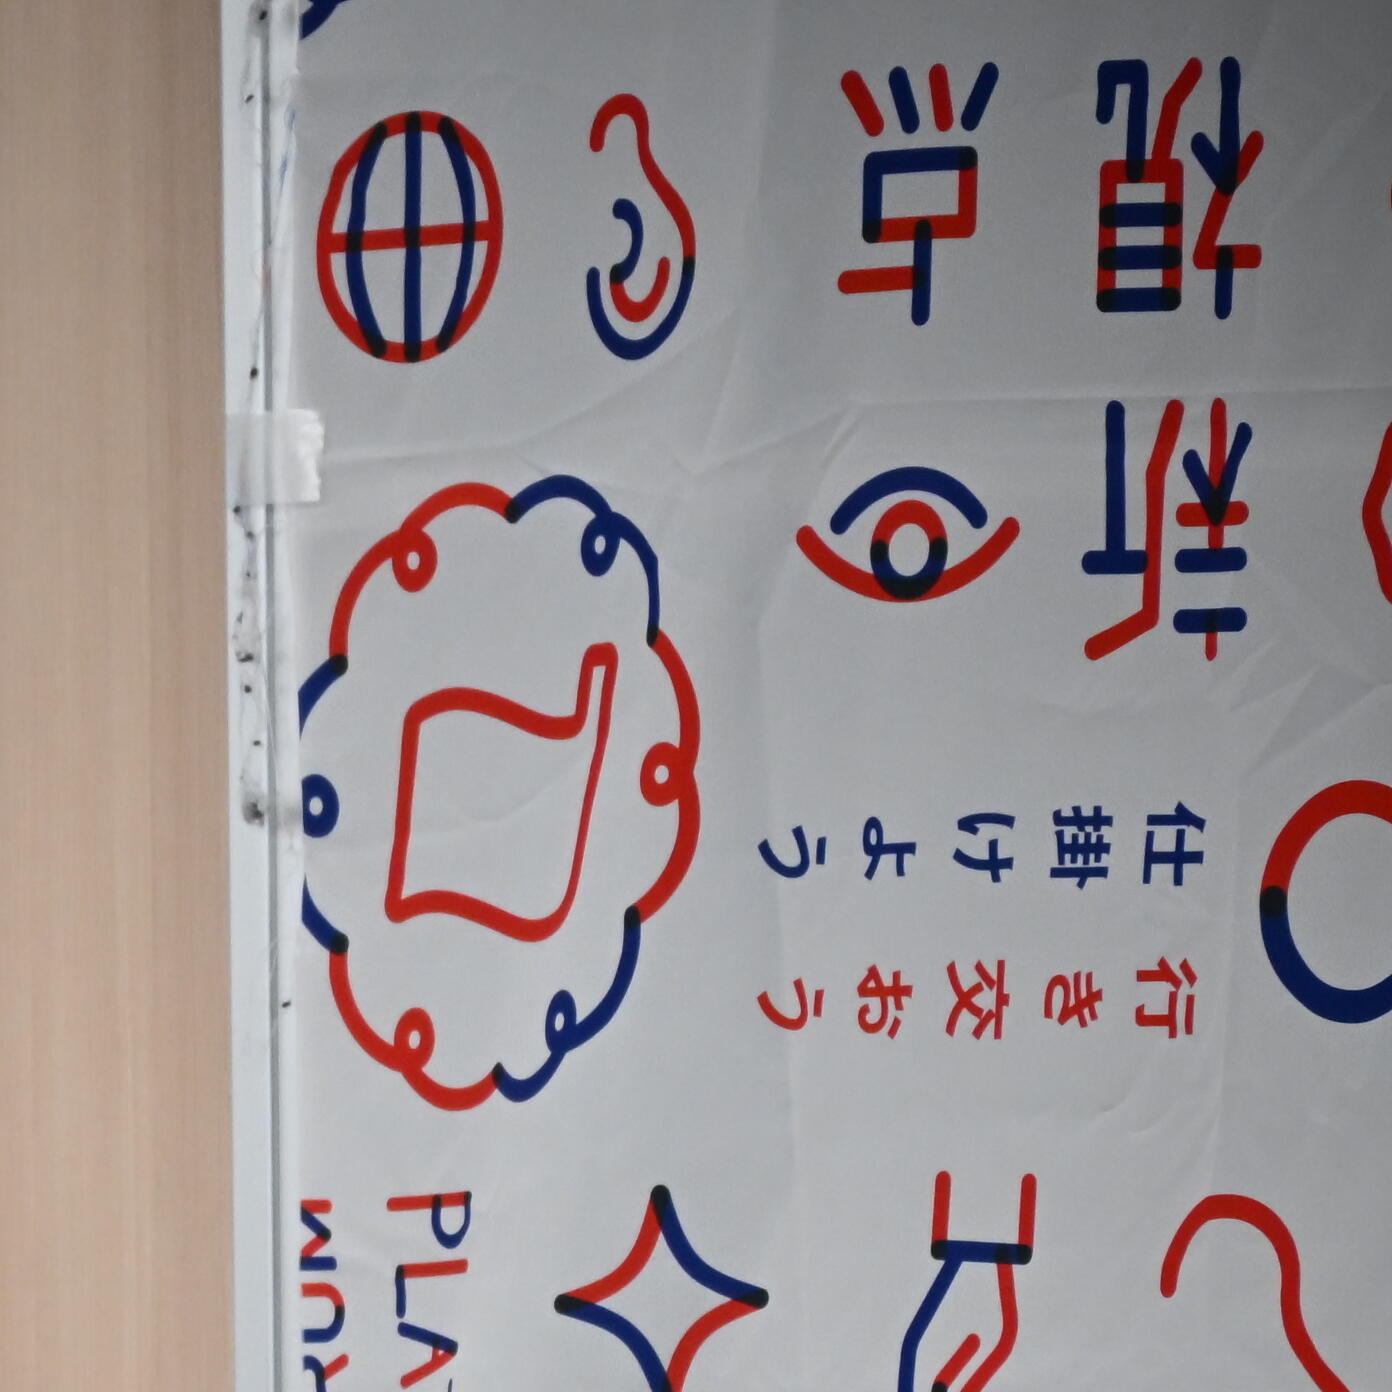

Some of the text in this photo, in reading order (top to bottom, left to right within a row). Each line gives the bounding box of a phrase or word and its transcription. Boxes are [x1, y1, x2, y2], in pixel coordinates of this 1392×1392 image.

[758, 801, 1207, 889] 仕掛けよう
[757, 956, 1198, 1040] 行き交おう
